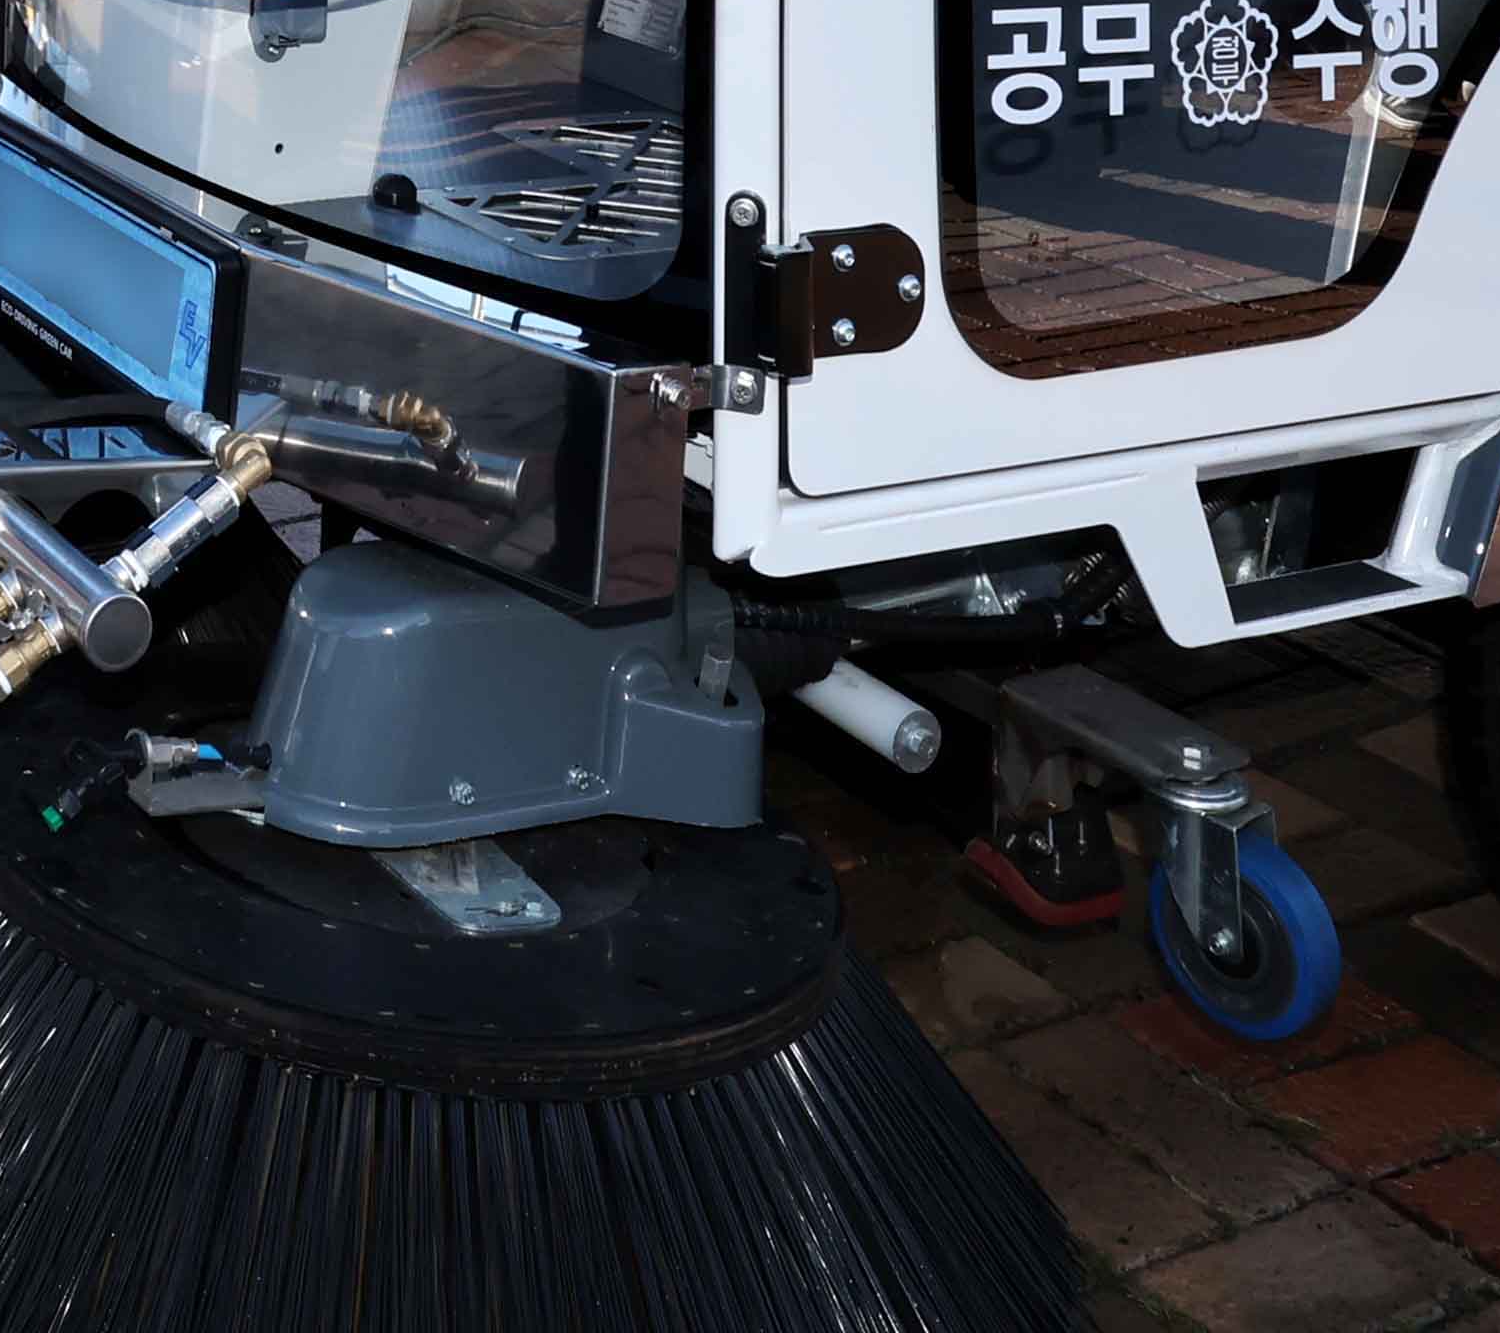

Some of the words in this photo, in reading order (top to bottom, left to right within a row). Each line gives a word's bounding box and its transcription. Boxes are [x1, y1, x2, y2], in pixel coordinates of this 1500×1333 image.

[986, 2, 1155, 126] 공무
[1211, 34, 1240, 87] 정부
[0, 299, 39, 337] ECO-DRIVING
[39, 326, 60, 354] GREEN
[59, 340, 74, 362] CAR
[179, 299, 208, 370] EV
